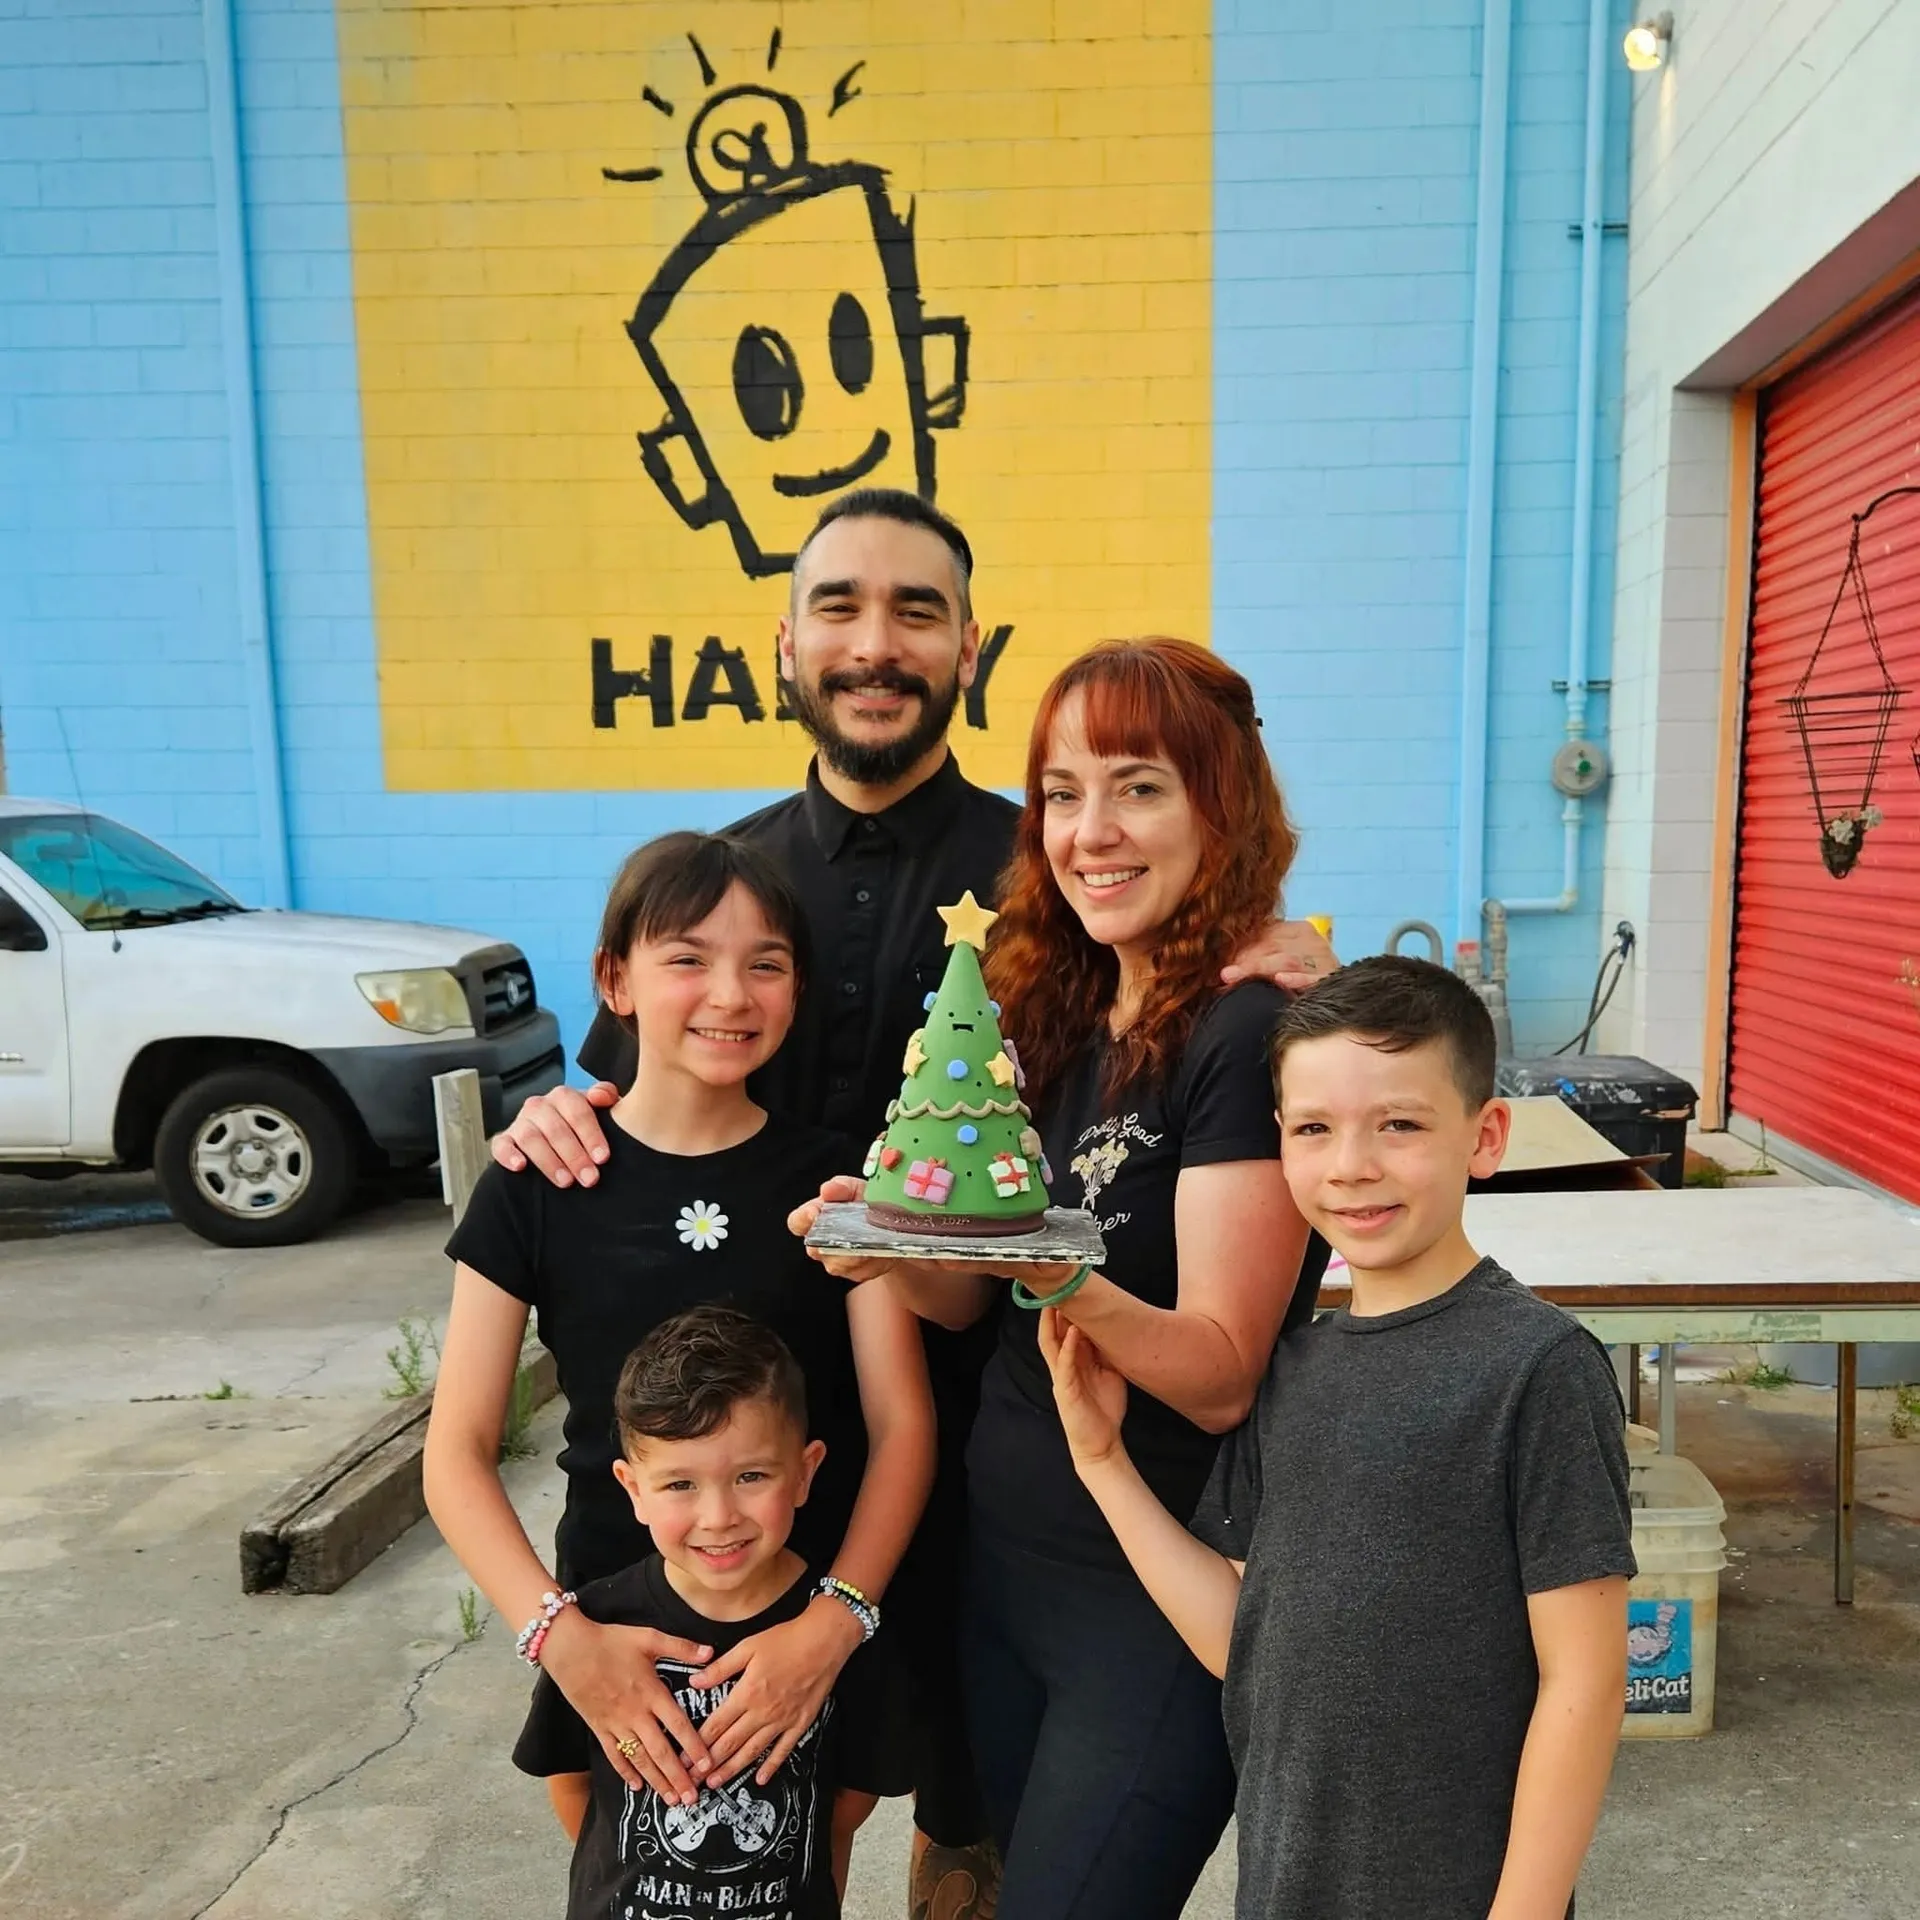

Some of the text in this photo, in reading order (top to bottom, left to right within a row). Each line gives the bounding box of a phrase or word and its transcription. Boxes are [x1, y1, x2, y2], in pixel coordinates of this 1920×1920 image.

[591, 624, 1015, 731] HAY
[1118, 1112, 1163, 1148] Good
[634, 1874, 693, 1907] MAN
[716, 1876, 790, 1911] BLACK
